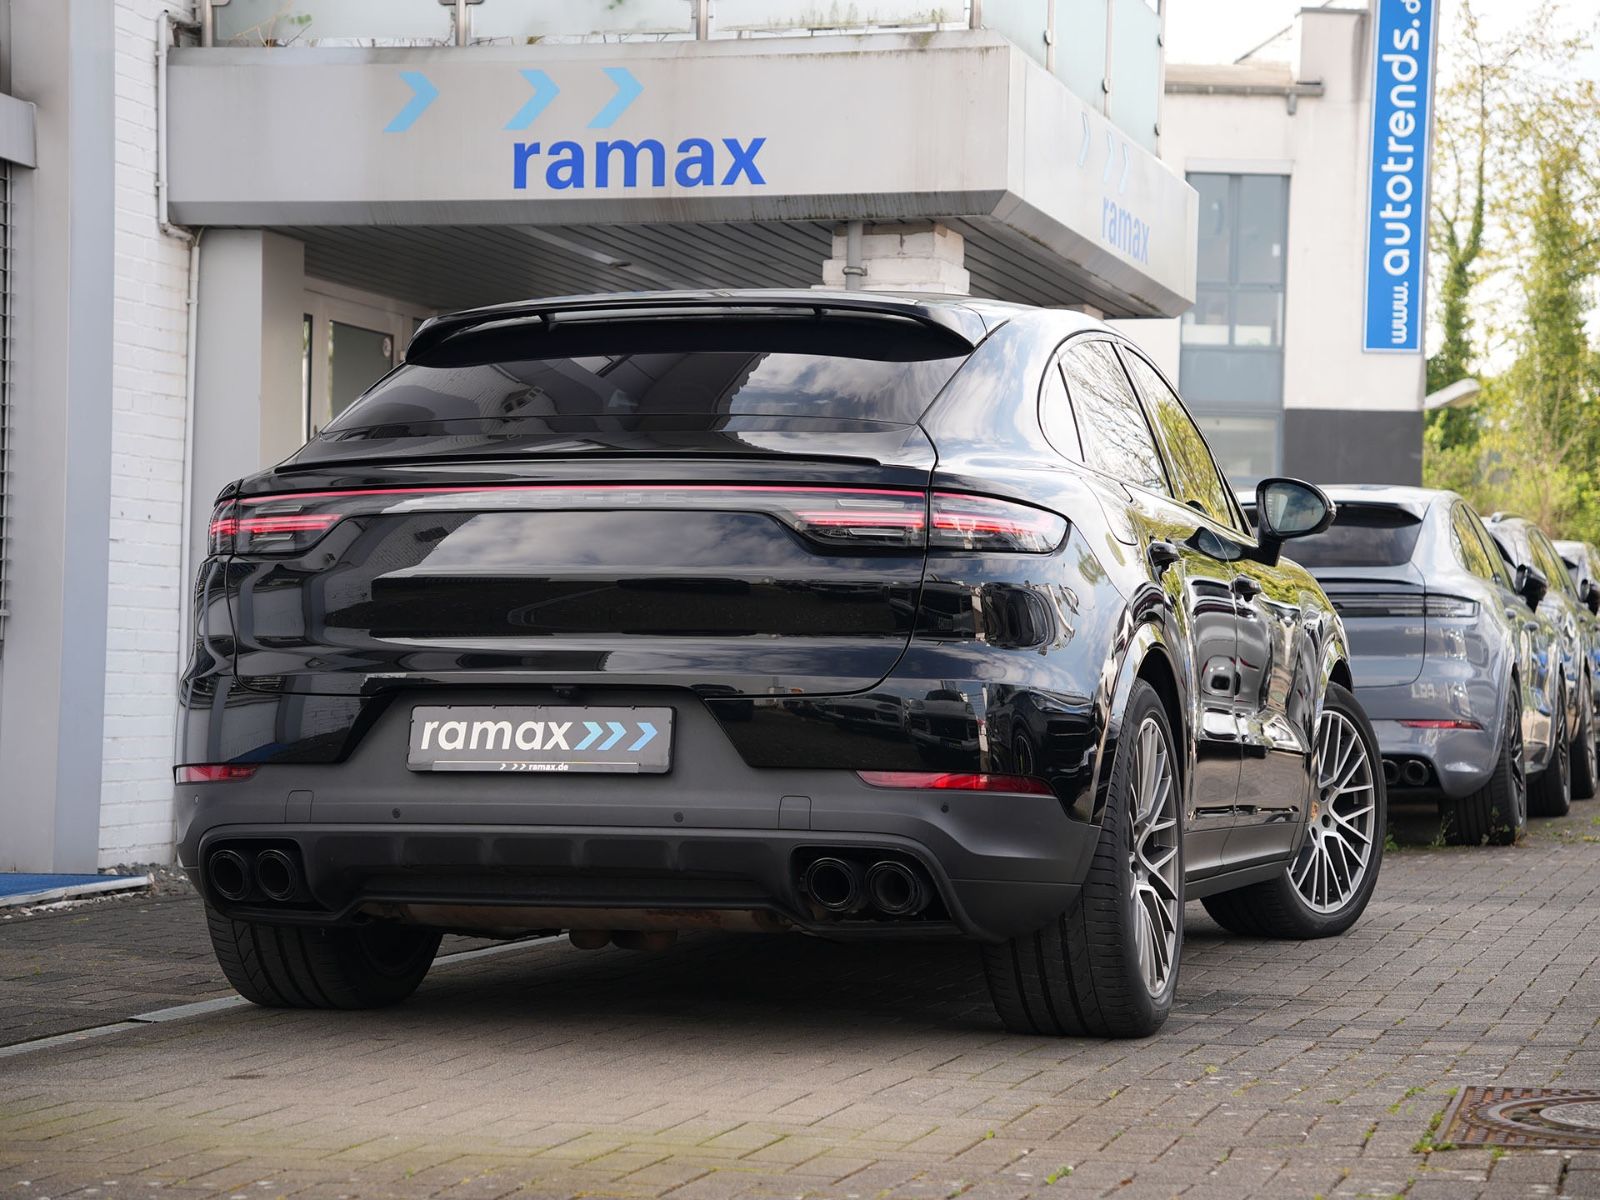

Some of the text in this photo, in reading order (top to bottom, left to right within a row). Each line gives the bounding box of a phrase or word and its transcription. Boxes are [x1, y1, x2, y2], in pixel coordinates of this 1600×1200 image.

[512, 137, 767, 190] ramax
[1102, 196, 1150, 265] ramax
[420, 720, 573, 751] ramax
[528, 762, 569, 771] ramax.de
